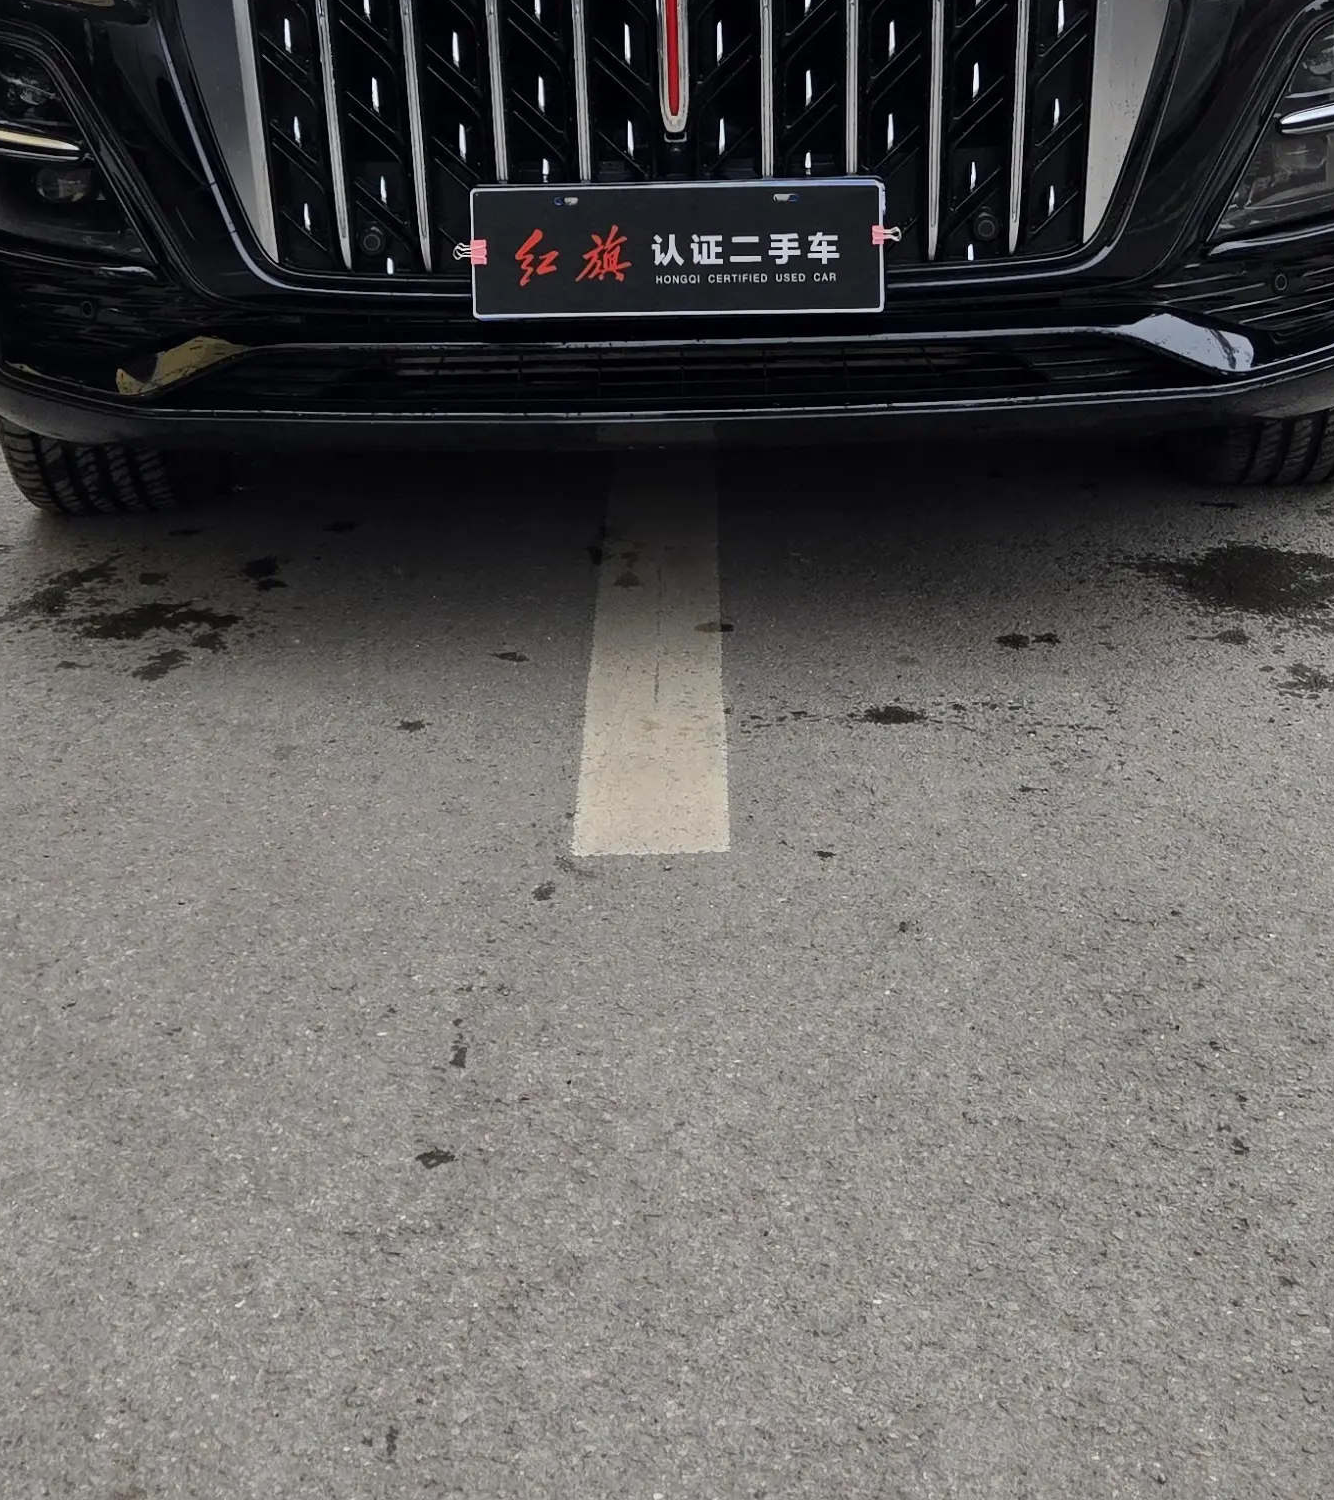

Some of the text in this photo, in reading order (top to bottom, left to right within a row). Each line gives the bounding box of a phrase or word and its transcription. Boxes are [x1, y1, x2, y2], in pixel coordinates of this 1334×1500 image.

[515, 225, 840, 287] 红旗 认证二手车
[655, 272, 837, 285] HONGQI CERTIFIED USED CAR
